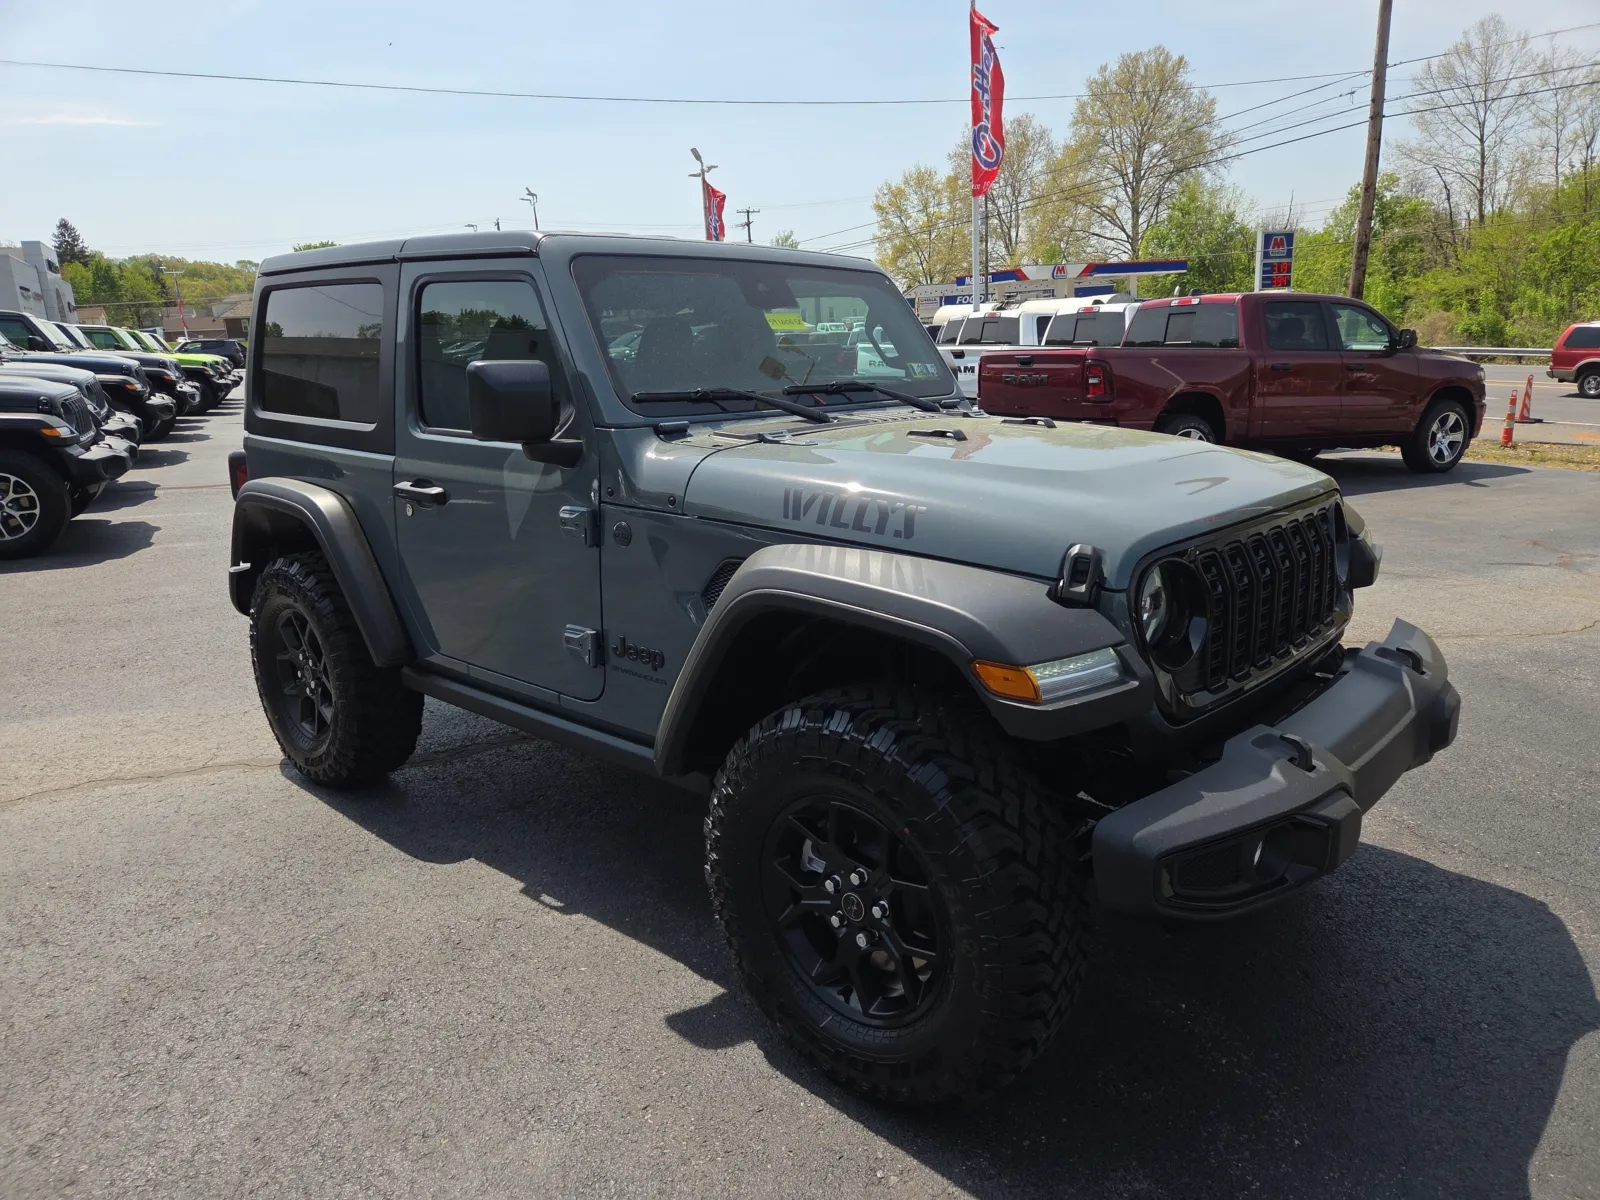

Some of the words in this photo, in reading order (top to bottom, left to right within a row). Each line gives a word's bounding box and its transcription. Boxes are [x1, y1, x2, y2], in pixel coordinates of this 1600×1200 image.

[964, 275, 993, 285] Mathn
[957, 365, 976, 374] AM
[1001, 374, 1049, 386] RAM
[782, 487, 927, 540] WILLYS
[611, 635, 666, 672] Jeep
